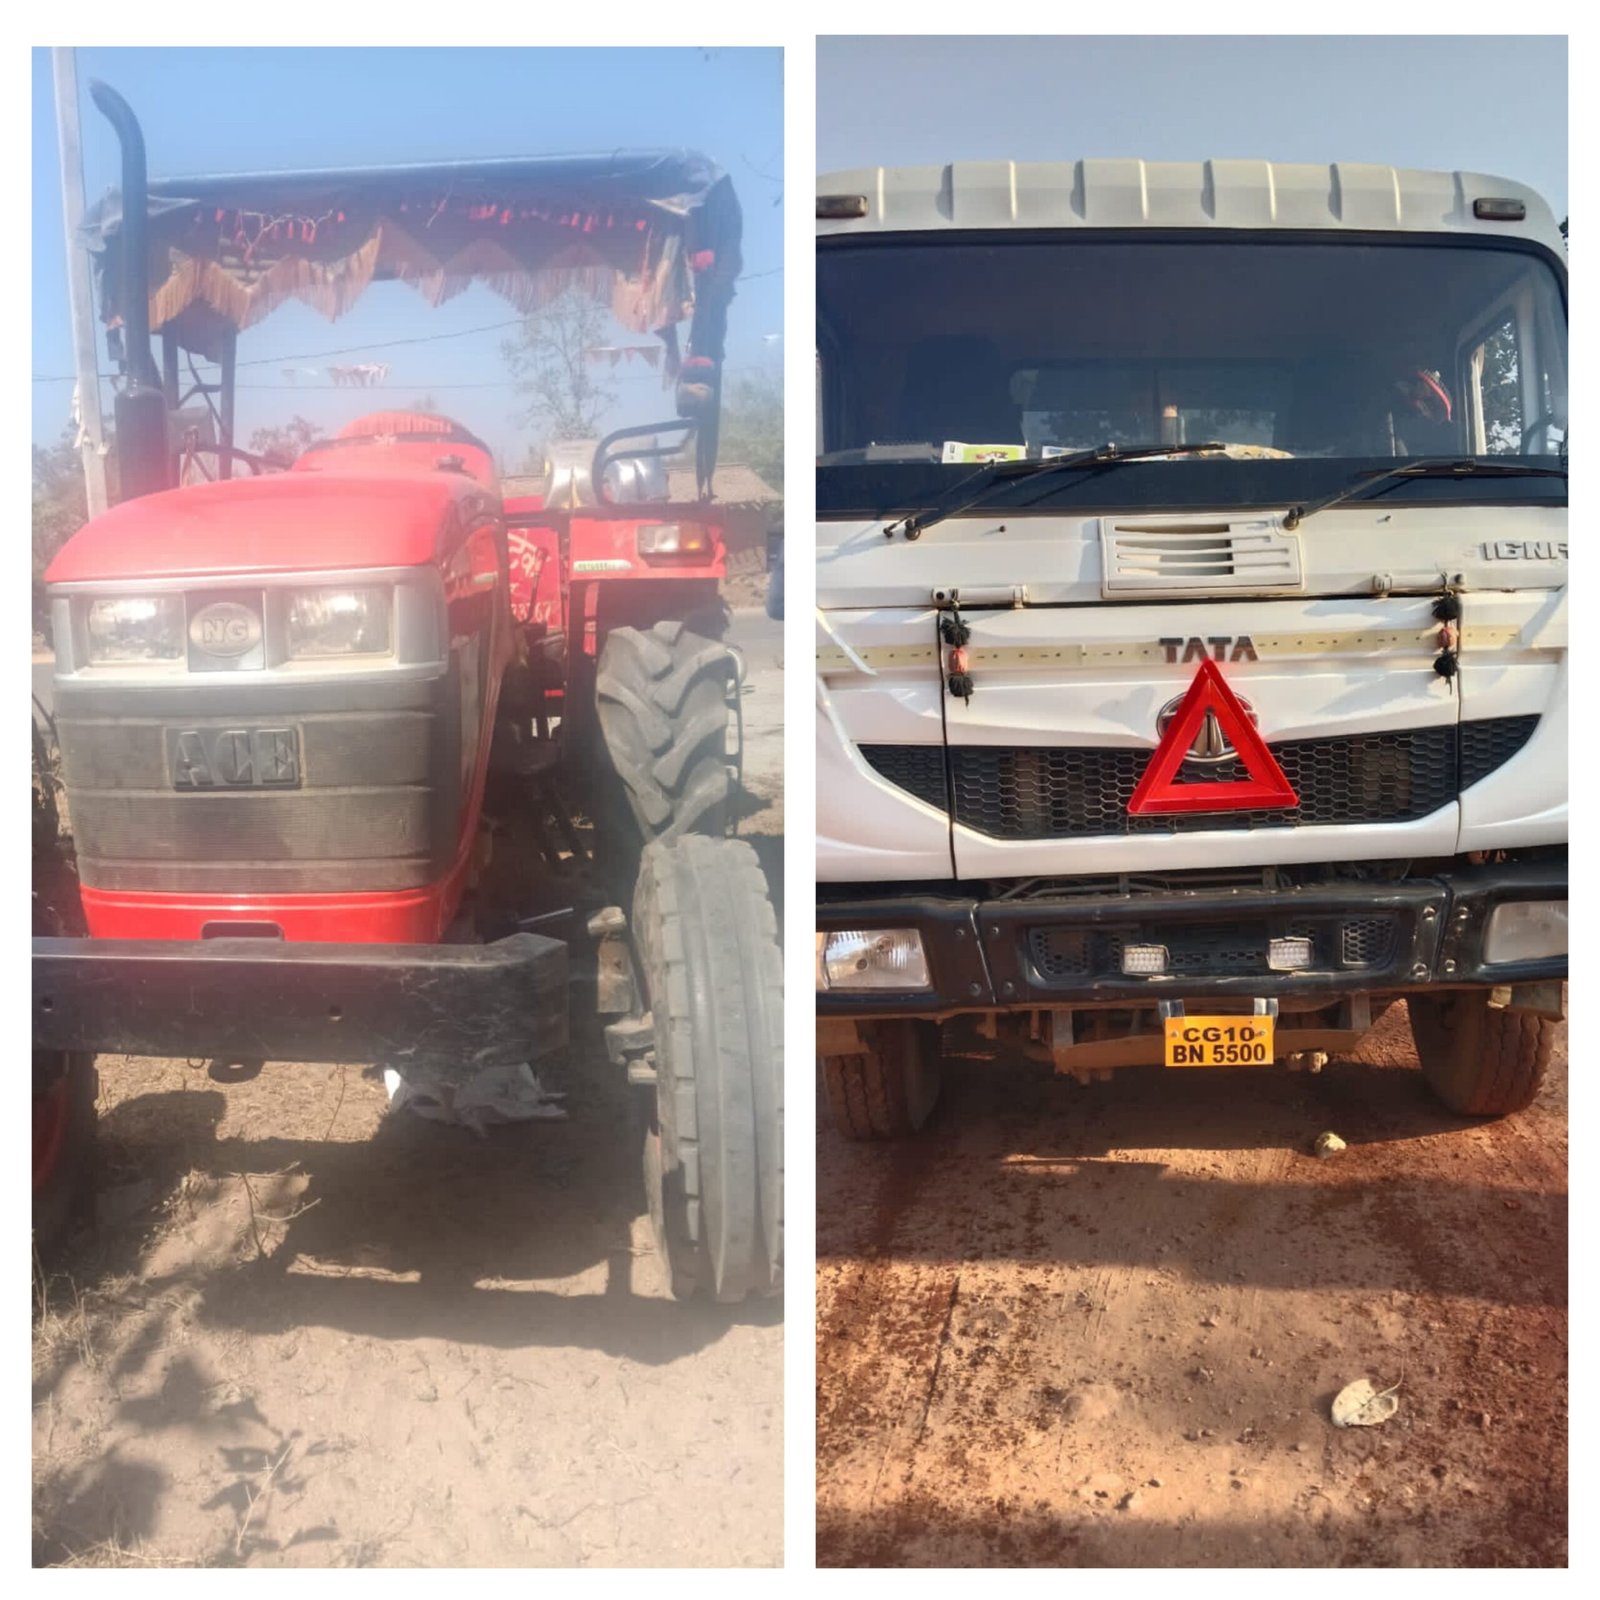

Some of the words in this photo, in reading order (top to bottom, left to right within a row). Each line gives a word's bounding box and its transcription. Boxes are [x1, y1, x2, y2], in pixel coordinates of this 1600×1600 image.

[202, 618, 249, 644] NG
[1158, 636, 1259, 663] TATA
[174, 730, 297, 784] ACE
[1182, 1026, 1255, 1043] CG10
[1173, 1044, 1205, 1064] BN
[1212, 1043, 1266, 1063] 5500
